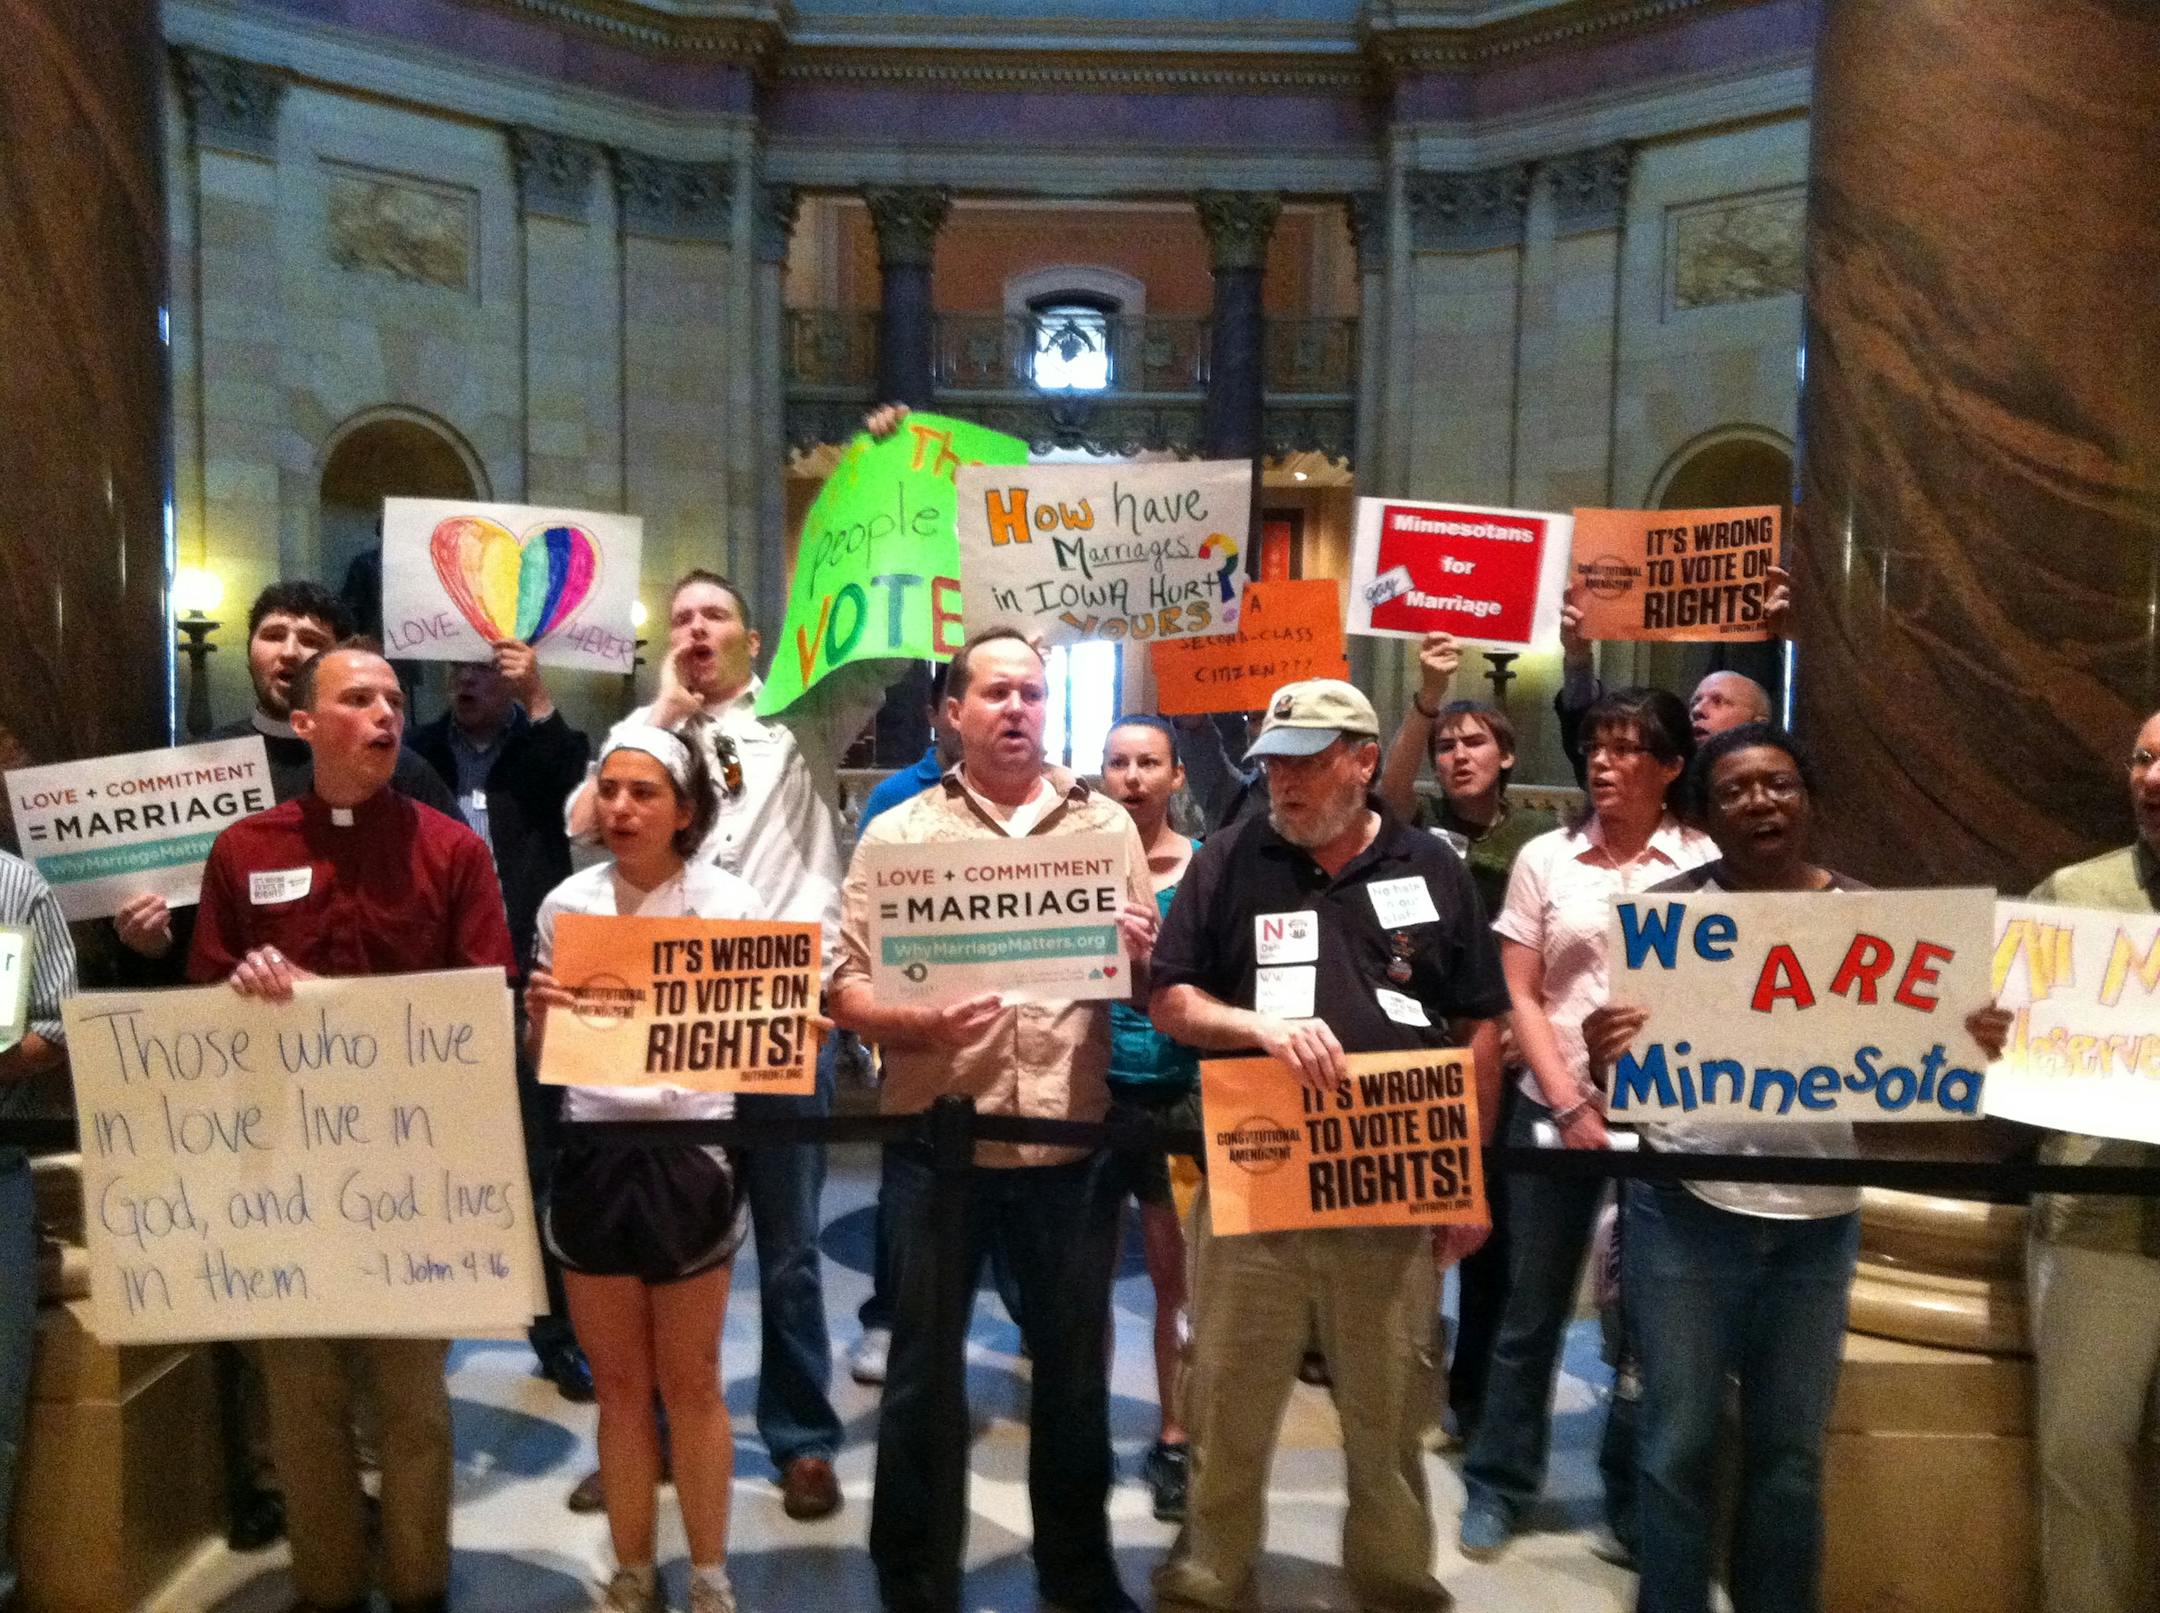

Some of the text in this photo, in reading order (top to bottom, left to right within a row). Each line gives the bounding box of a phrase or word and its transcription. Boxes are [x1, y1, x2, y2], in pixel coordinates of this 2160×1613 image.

[909, 424, 984, 484] Th
[1114, 481, 1208, 536] have
[1391, 512, 1535, 544] Minnesotans
[810, 480, 940, 599] people
[1052, 535, 1195, 581] Marriages
[1646, 516, 1774, 557] IT'S WRONG
[1440, 555, 1476, 576] for
[1646, 548, 1774, 587] TO VOTE ON
[992, 587, 1022, 613] in
[1404, 590, 1503, 618] Marriage
[387, 612, 460, 651] LOVE
[796, 573, 966, 690] VOTE
[20, 788, 78, 811] LOVE
[106, 762, 256, 798] COMMITMENT
[877, 869, 935, 887] LOVE
[964, 859, 1115, 883] COMMITMENT
[654, 933, 811, 975] IT'S WRONG
[1616, 902, 1738, 970] We
[653, 974, 810, 1016] TO VOTE ON
[1751, 932, 1955, 1014] ARE
[79, 1003, 481, 1085] Those who live
[646, 1016, 807, 1073] RIGHTS!
[1358, 1062, 1465, 1107] WRONG
[1610, 1040, 1985, 1116] Minnesota
[94, 1088, 435, 1156] in love live in
[1305, 1103, 1468, 1154] TO VOTE ON
[1308, 1147, 1472, 1213] RIGHTS!
[101, 1169, 516, 1252] God, and God lives
[121, 1266, 173, 1317] in
[404, 1253, 455, 1286] John
